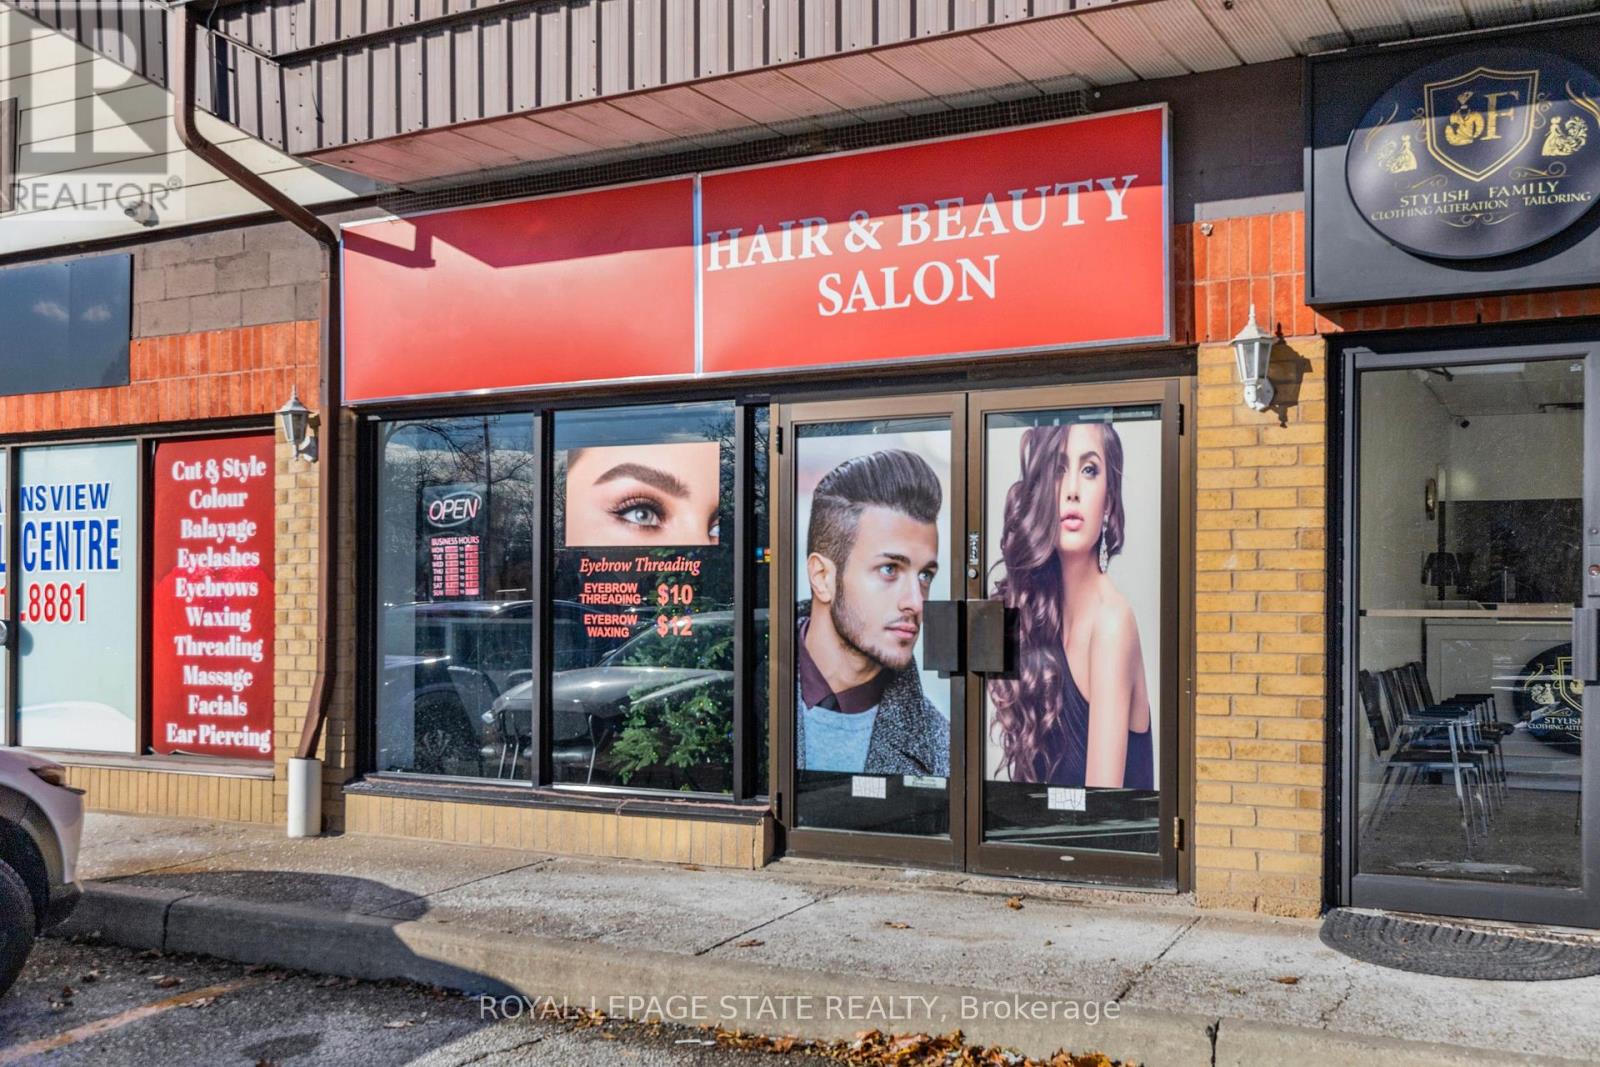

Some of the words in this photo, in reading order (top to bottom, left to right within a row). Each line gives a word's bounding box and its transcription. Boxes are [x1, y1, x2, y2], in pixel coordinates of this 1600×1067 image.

[1370, 206, 1433, 222] CLOTHING
[1435, 199, 1509, 216] ALTERATION
[1523, 190, 1592, 207] TAILORING
[1400, 189, 1470, 208] STYLISH
[1489, 181, 1560, 199] FAMILY
[706, 215, 833, 272] HAIR
[844, 210, 884, 253] &
[898, 174, 1139, 247] BEAUTY
[817, 254, 1001, 318] SALON
[172, 461, 203, 482] Cut
[205, 458, 221, 484] &
[222, 455, 266, 483] Style
[189, 488, 249, 510] Colour
[428, 498, 478, 521] OPEN
[180, 517, 257, 544] Balayage
[431, 536, 458, 546] BUSINESS
[458, 535, 480, 545] HOURS
[22, 519, 119, 572] CENTRE
[177, 546, 260, 573] Eyelashes
[579, 557, 632, 577] Eyebrow
[635, 555, 702, 577] Threading
[175, 577, 259, 603] Eyebrows
[579, 593, 641, 605] THREADING
[657, 583, 694, 606] $10
[584, 582, 638, 594] EYEBROW
[185, 606, 251, 632] Waxing
[583, 614, 638, 626] EYEBROW
[587, 626, 630, 638] WAXING
[656, 614, 693, 638] $12
[174, 635, 264, 662] Threading
[183, 665, 253, 692] Massage
[188, 694, 248, 717] Facials
[166, 723, 195, 744] Ear
[198, 725, 271, 752] Piercing
